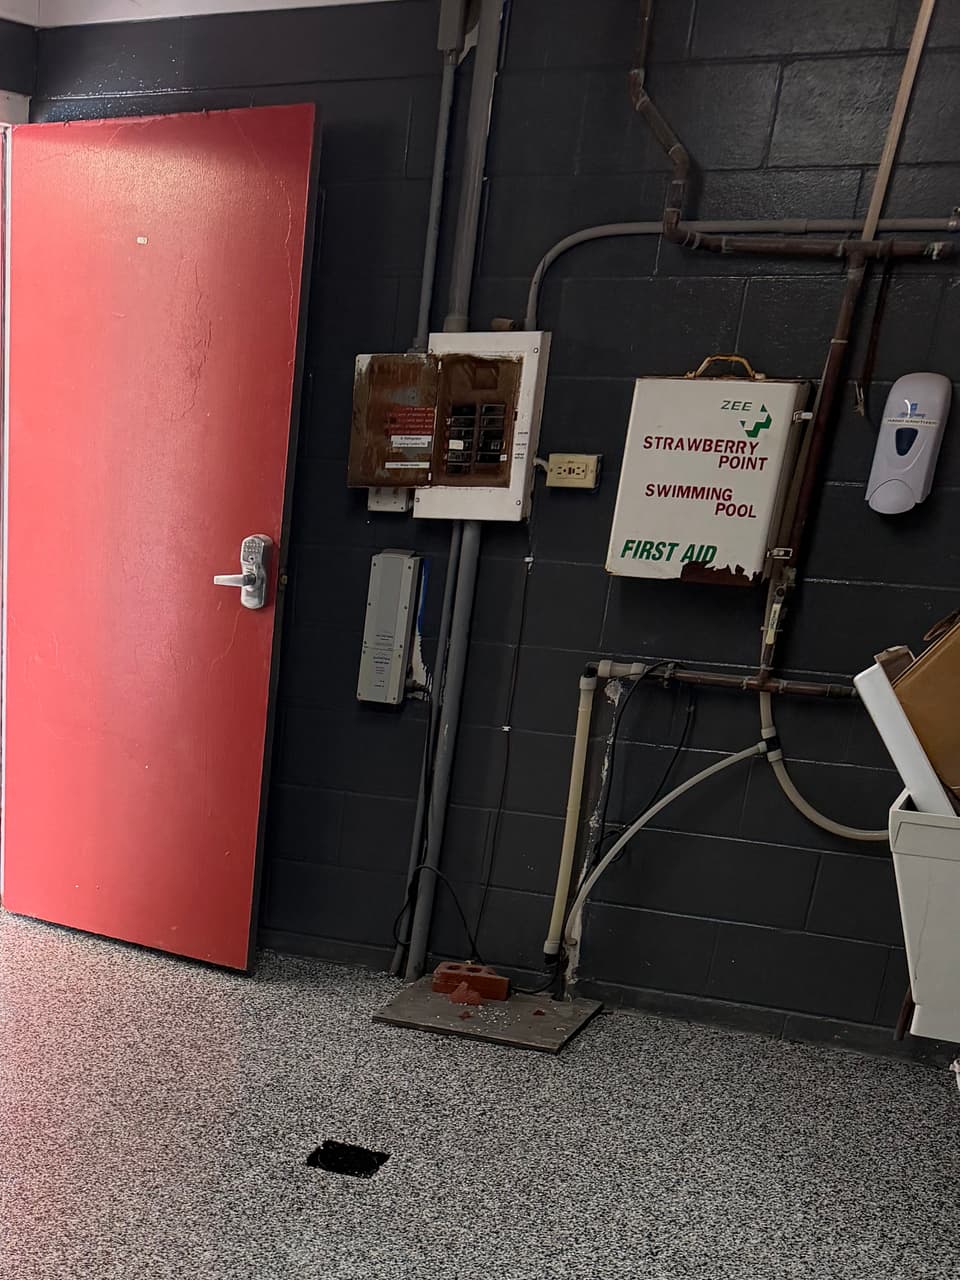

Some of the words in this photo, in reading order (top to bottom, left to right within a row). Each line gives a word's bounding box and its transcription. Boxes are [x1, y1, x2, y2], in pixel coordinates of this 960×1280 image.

[720, 400, 753, 411] ZEE
[643, 436, 759, 455] STRAWBERRY
[718, 455, 768, 471] POINT
[645, 484, 733, 501] SWIMMING
[715, 502, 757, 518] POOL
[620, 539, 680, 561] FIRST
[680, 544, 718, 563] AID
